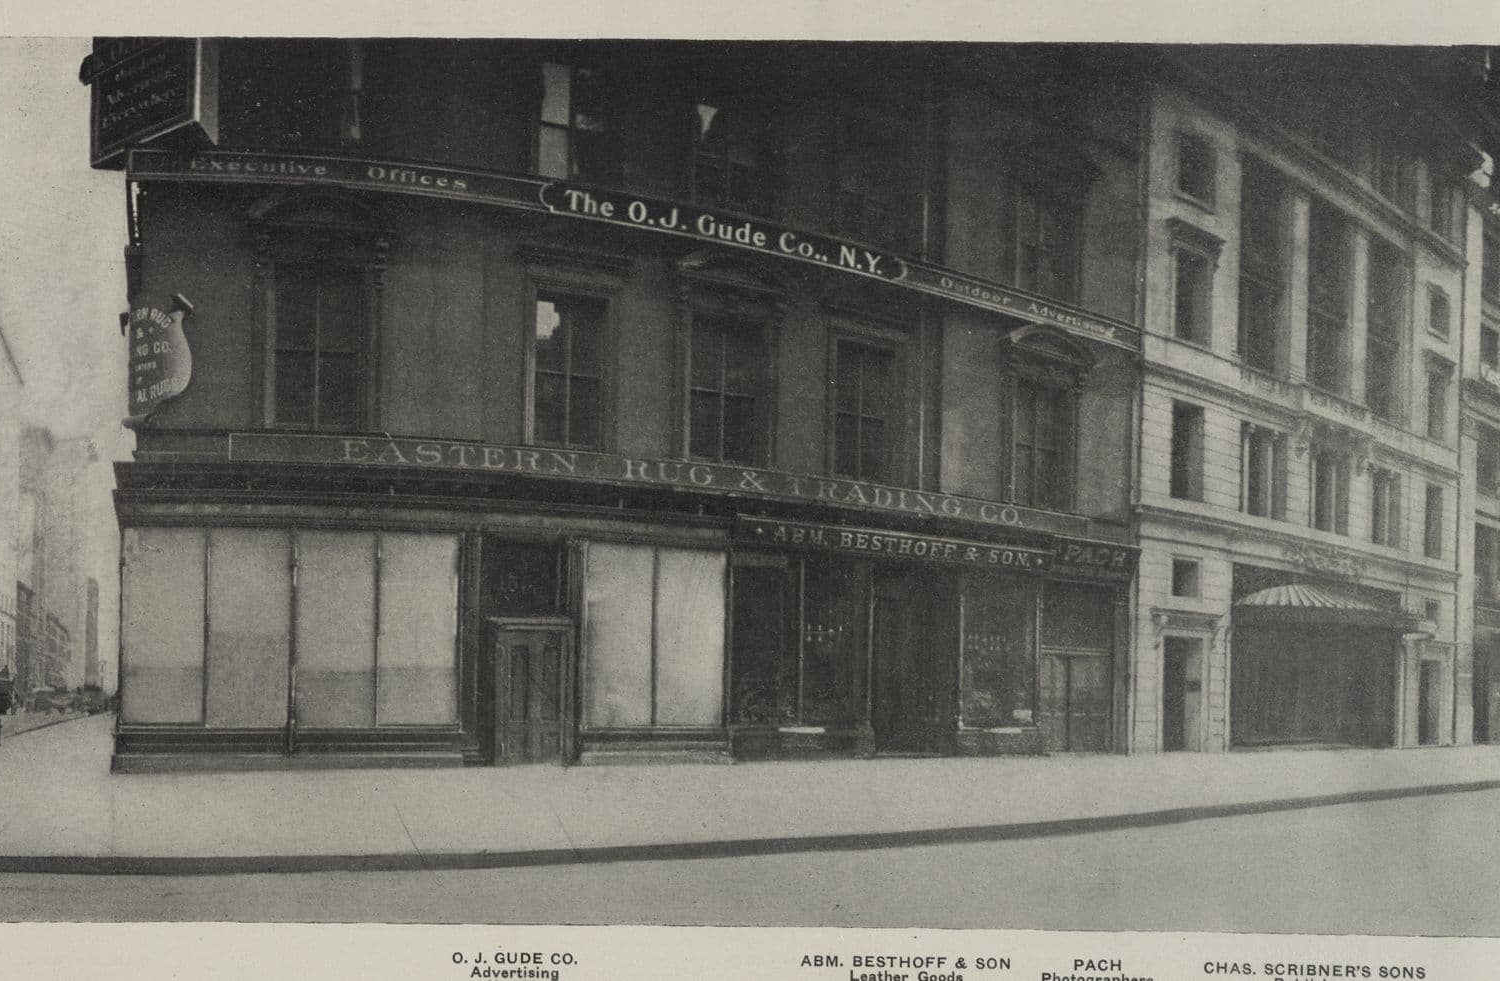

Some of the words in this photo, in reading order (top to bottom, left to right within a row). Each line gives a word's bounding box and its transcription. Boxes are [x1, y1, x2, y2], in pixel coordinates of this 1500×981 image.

[190, 158, 327, 176] Executive
[367, 166, 467, 190] Offices
[564, 189, 614, 217] The
[697, 215, 767, 247] Gude
[940, 277, 1012, 305] Outdoor
[150, 308, 172, 329] RUG
[340, 439, 577, 474] EASTERN
[623, 459, 714, 487] RUG
[739, 471, 764, 492] &
[790, 477, 963, 518] TRADING
[772, 525, 828, 548] ABM.
[839, 532, 957, 561] BESTHOFF
[965, 547, 979, 562] &
